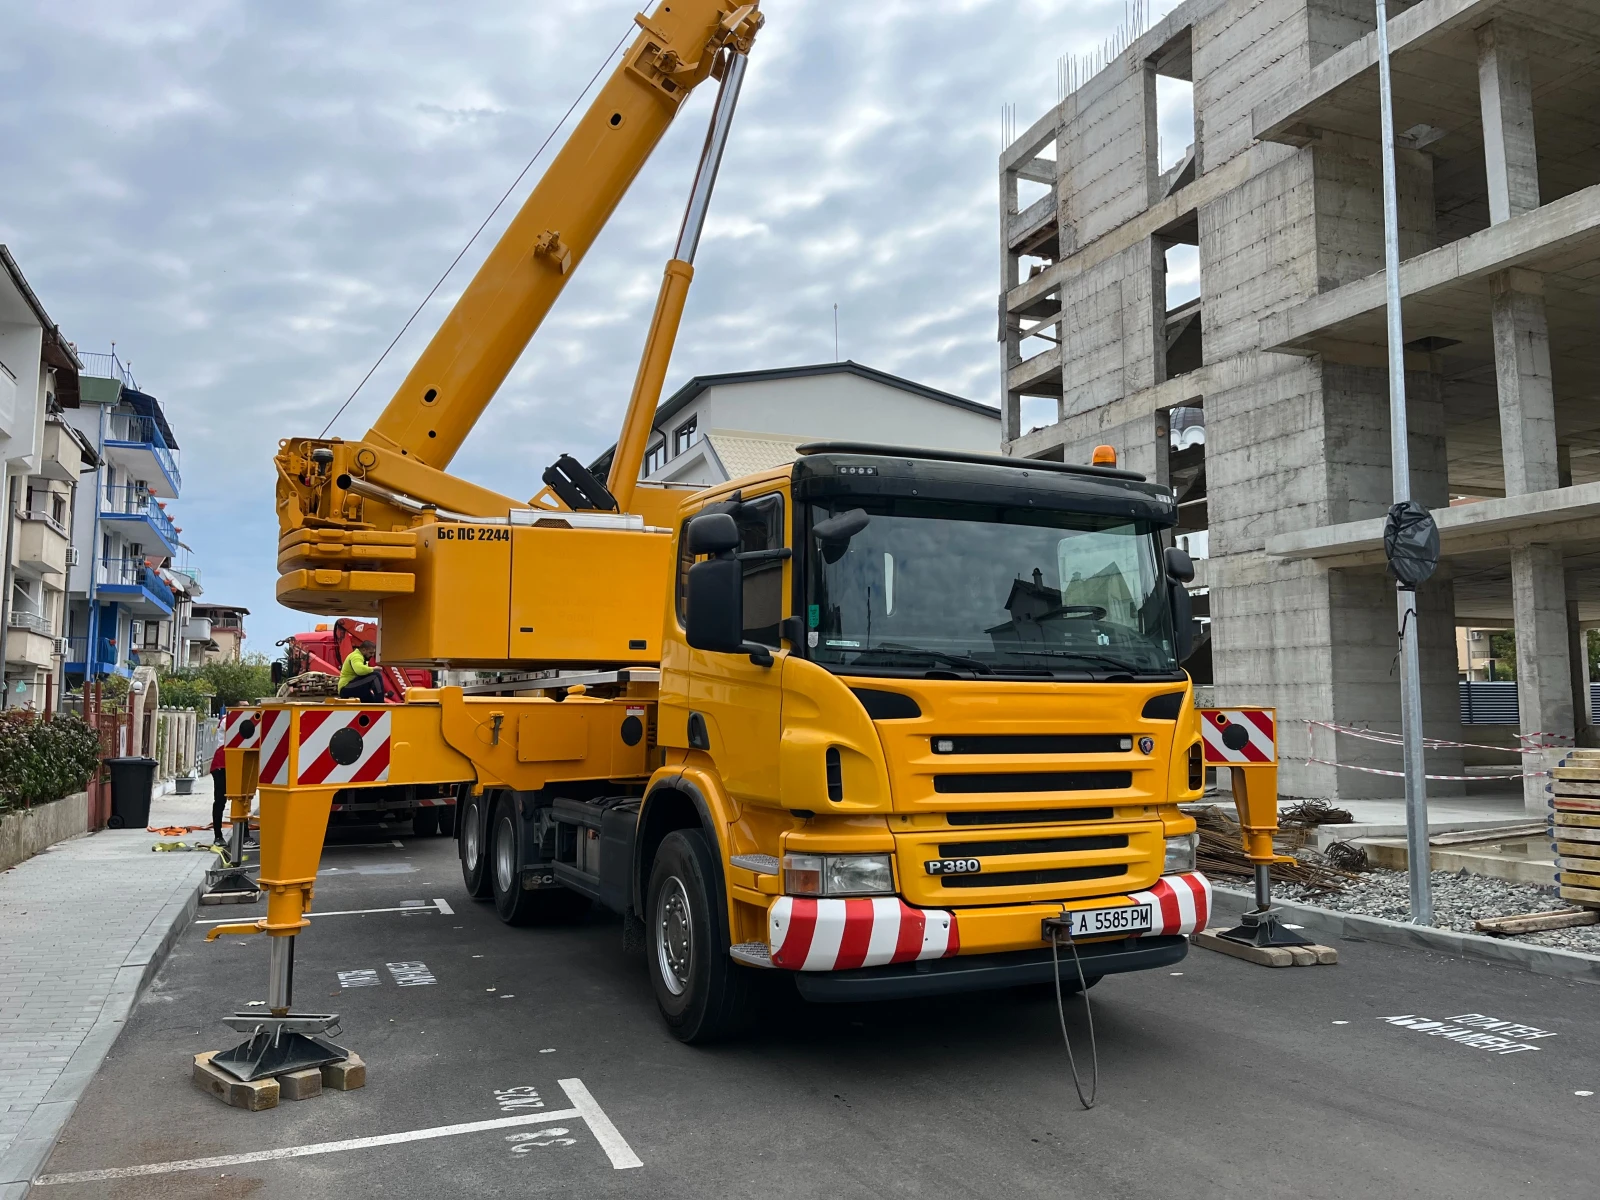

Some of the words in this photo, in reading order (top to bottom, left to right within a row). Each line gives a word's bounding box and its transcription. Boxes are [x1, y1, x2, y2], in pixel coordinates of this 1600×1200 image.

[437, 527, 454, 540] Бс
[457, 527, 475, 541] ПС
[478, 528, 510, 541] 2244
[1079, 914, 1088, 932] A
[1095, 910, 1129, 930] 5585
[1131, 908, 1149, 926] PM
[1375, 1014, 1541, 1055] АБОНАМЕНТ
[1444, 1013, 1558, 1040] ПЛАТЕН
